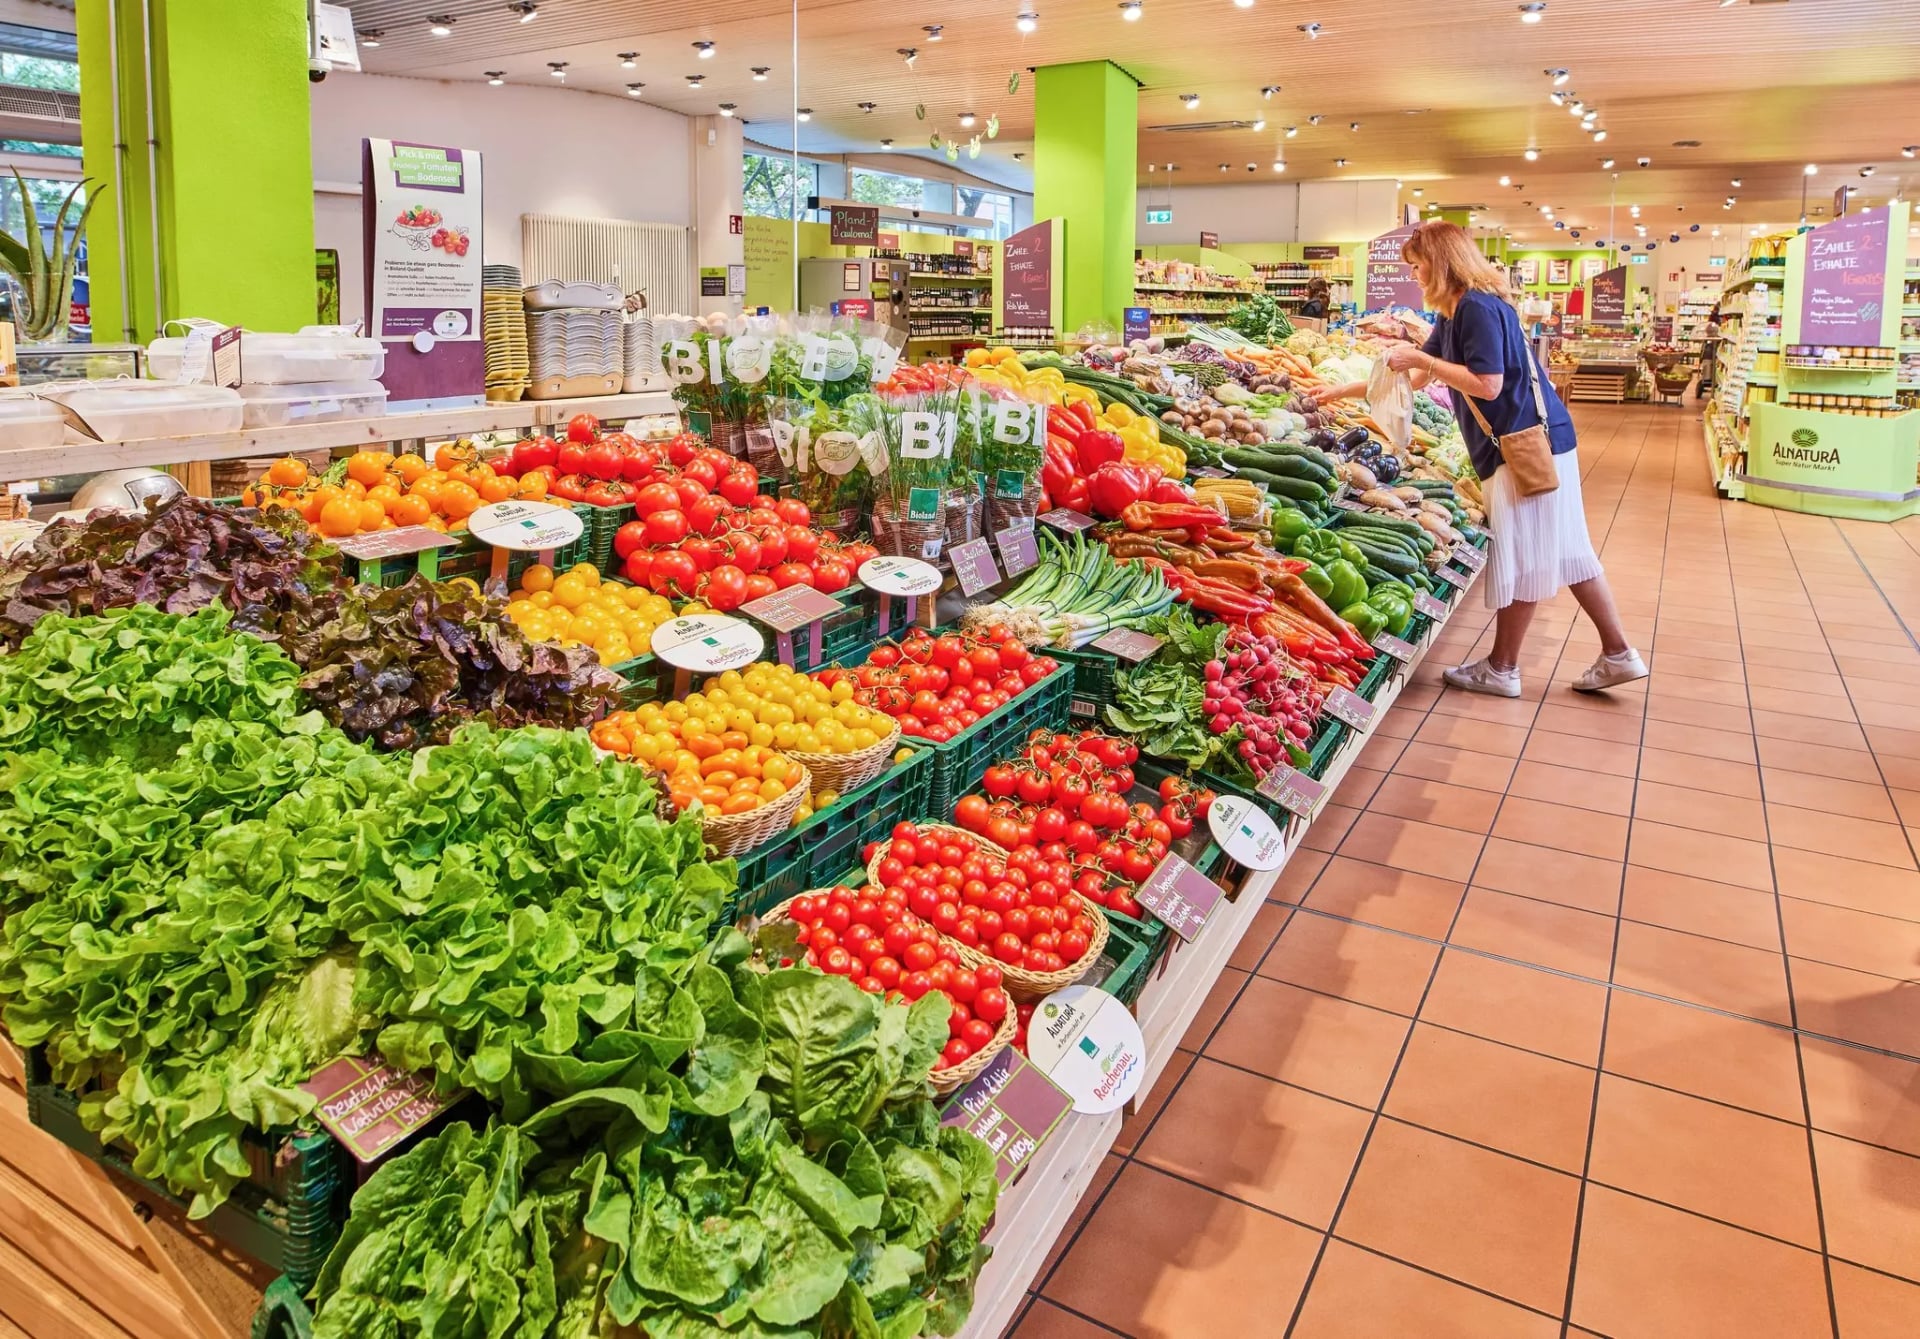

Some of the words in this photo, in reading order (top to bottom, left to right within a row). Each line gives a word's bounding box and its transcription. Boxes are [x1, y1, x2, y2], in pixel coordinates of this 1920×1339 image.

[422, 162, 458, 172] Tomaten
[417, 172, 457, 183] Bodensee
[840, 228, 874, 240] automat
[1374, 240, 1401, 251] Zahle
[1368, 251, 1400, 261] erhalte
[1775, 459, 1792, 467] Super
[1793, 461, 1812, 469] Natur
[996, 488, 1023, 500] Bioland
[910, 509, 936, 520] Bioland
